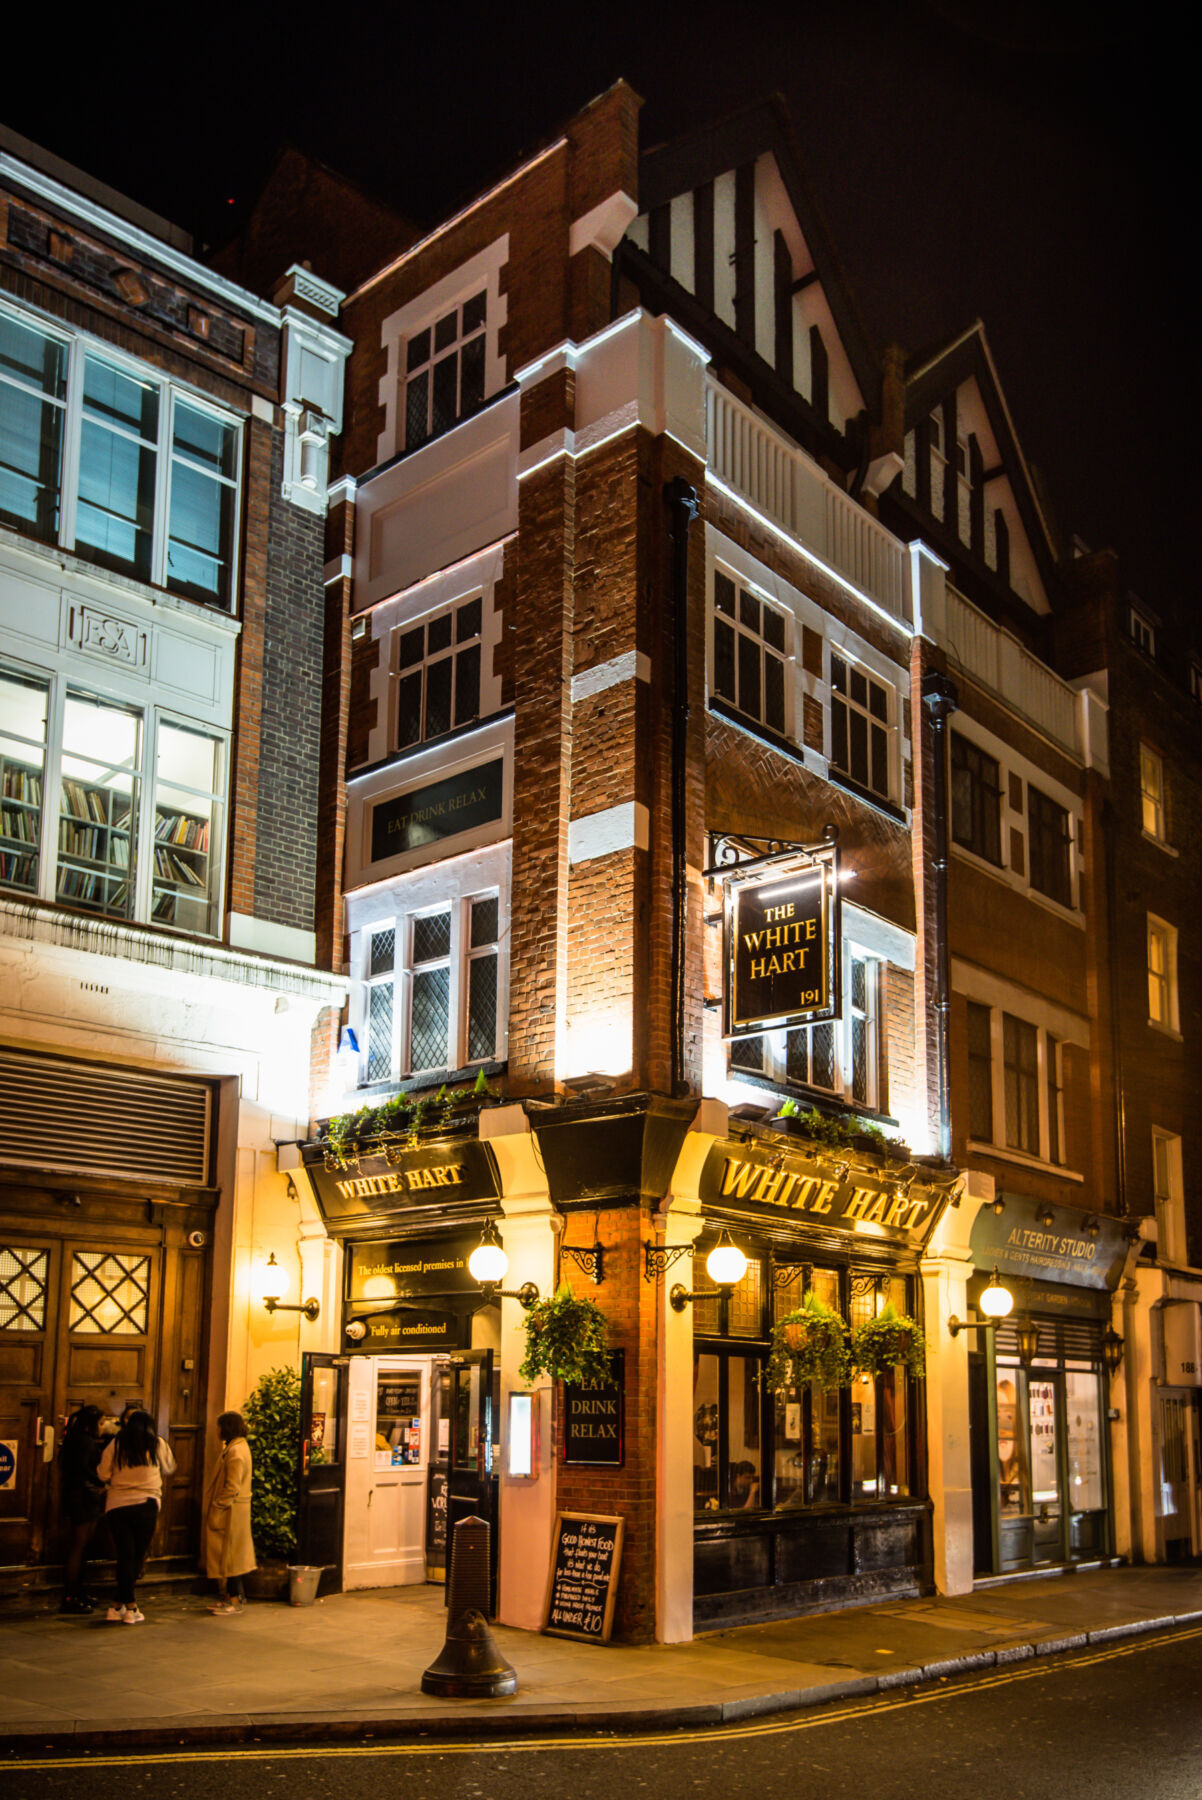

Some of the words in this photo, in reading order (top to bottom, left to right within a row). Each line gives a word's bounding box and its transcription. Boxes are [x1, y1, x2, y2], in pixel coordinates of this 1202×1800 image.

[387, 815, 408, 834] EAT
[409, 801, 446, 825] DRINK
[448, 786, 487, 812] RELAX
[763, 902, 795, 923] THE
[743, 918, 817, 953] WHITE
[750, 947, 809, 980] HART
[800, 988, 820, 1006] 191
[335, 1172, 403, 1199] WHITE
[404, 1164, 463, 1191] HART
[720, 1157, 840, 1215] WHITE
[841, 1186, 929, 1230] HART
[1007, 1227, 1060, 1254] ALTERITY
[1058, 1237, 1096, 1260] STUDIO
[358, 1265, 371, 1276] The
[373, 1263, 393, 1275] oldest
[394, 1260, 422, 1273] licensed
[423, 1258, 455, 1273] premises
[456, 1258, 464, 1268] in
[371, 1325, 390, 1338] Fully
[390, 1324, 401, 1335] air
[402, 1322, 447, 1336] conditioned
[571, 1400, 617, 1415] DRINK
[570, 1423, 617, 1439] RELAX
[597, 1537, 614, 1551] FOOD
[583, 1612, 602, 1632] £10
